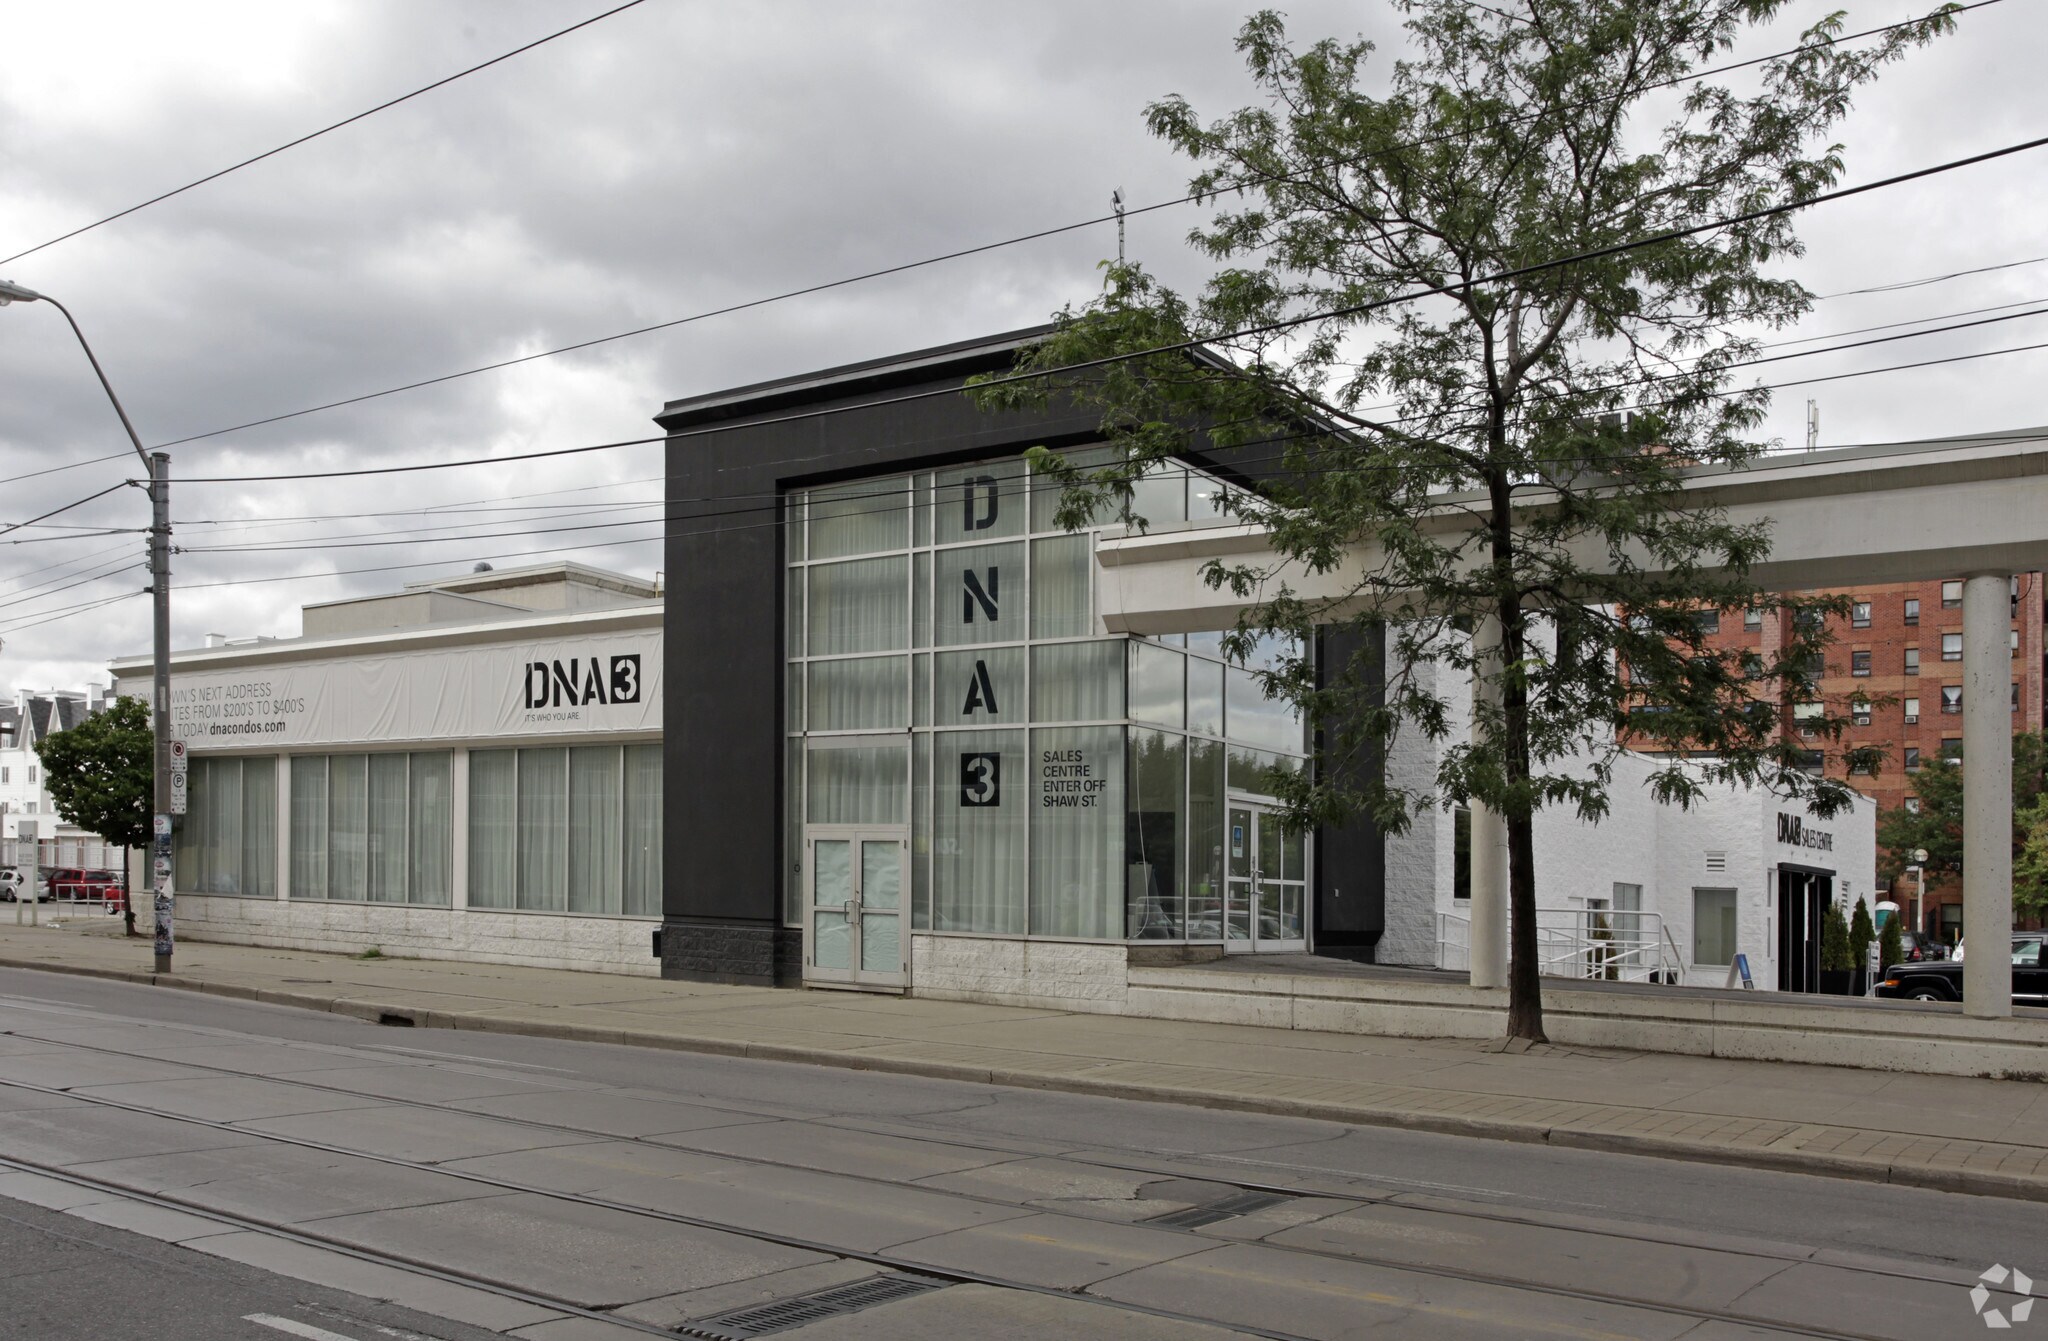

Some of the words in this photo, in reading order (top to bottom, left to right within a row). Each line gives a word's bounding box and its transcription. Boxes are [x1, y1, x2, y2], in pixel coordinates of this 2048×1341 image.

[199, 686, 223, 702] NEXT
[225, 682, 272, 700] ADDRESS
[193, 704, 221, 719] FROM
[223, 701, 254, 718] $200'S
[257, 700, 270, 715] TO
[273, 697, 305, 715] $400'S
[524, 714, 536, 722] IT'S
[536, 713, 552, 722] WHO
[552, 712, 567, 721] YOU
[177, 722, 209, 737] TODAY
[210, 720, 286, 736] dnacondos.com
[1043, 750, 1083, 763] SALES
[1043, 765, 1090, 777] CENTRE
[1043, 780, 1082, 792] ENTER
[1083, 779, 1107, 792] OFF
[1043, 795, 1079, 807] SHAW
[1081, 795, 1098, 807] ST.
[1801, 827, 1816, 849] SALES
